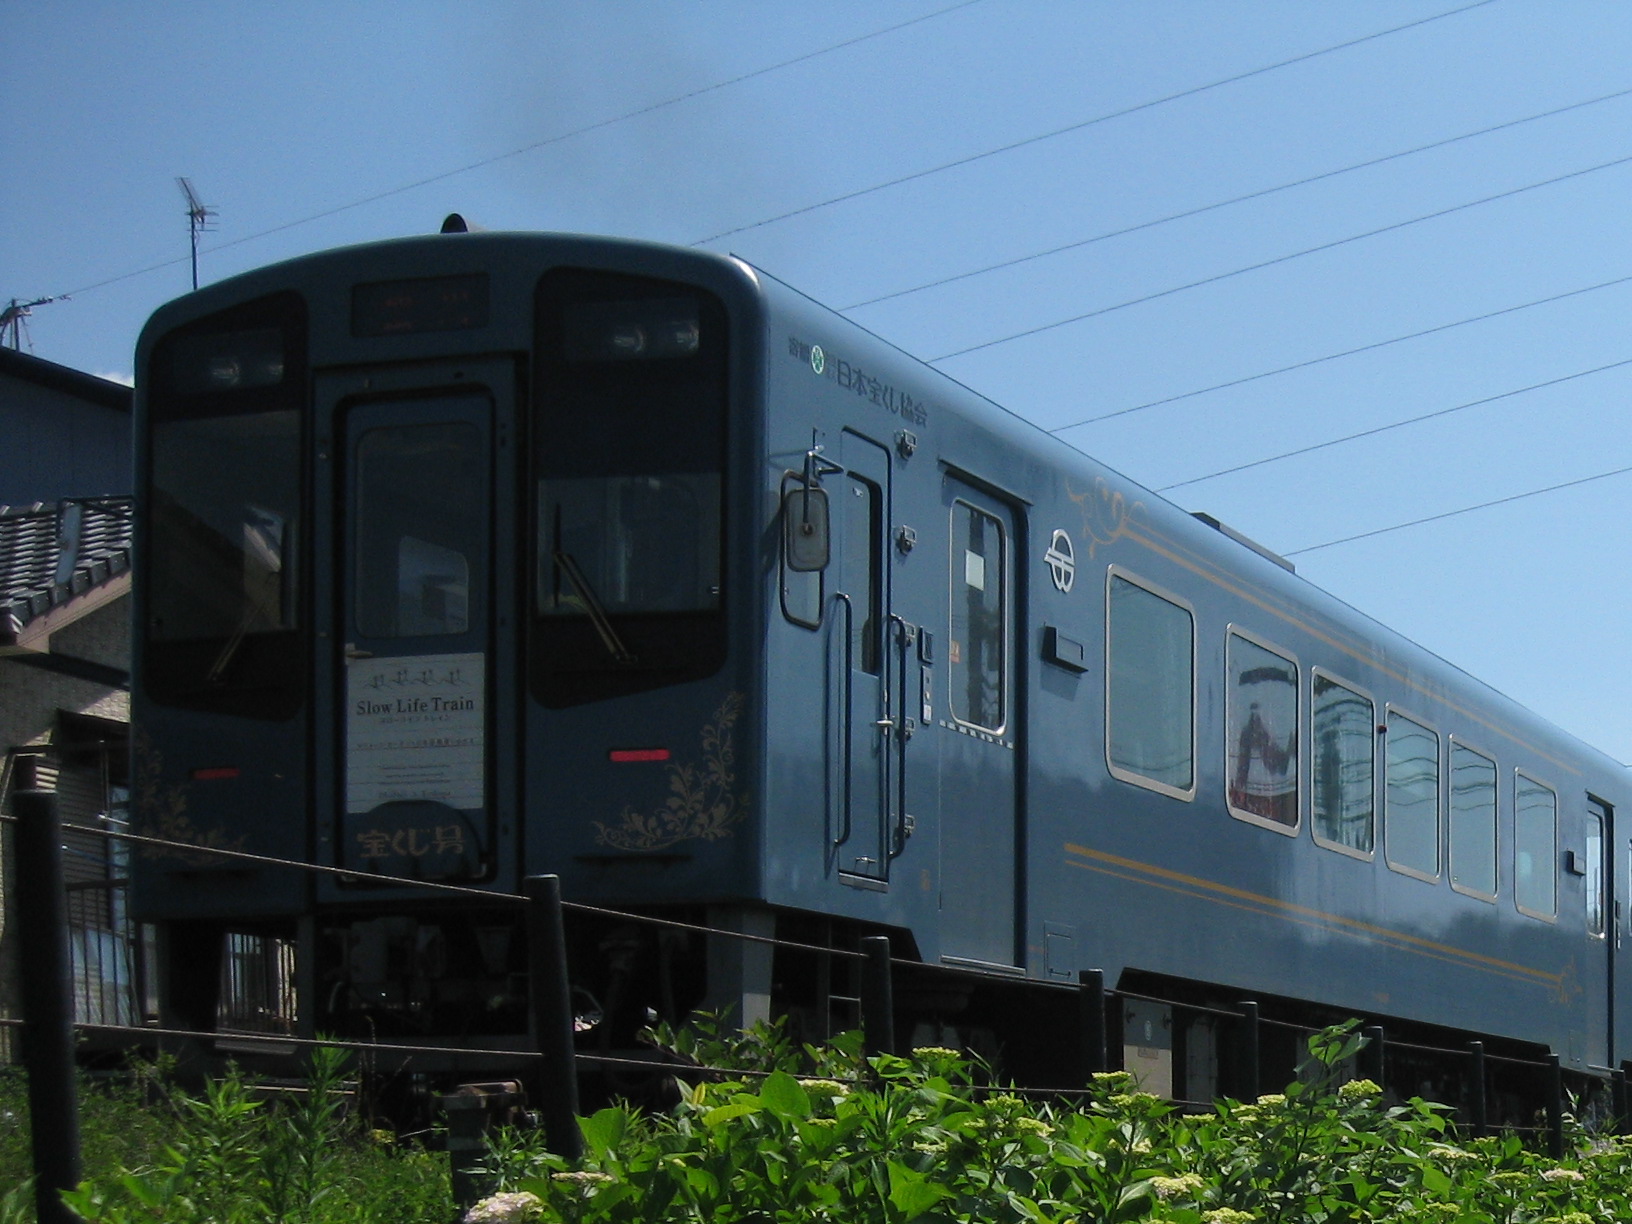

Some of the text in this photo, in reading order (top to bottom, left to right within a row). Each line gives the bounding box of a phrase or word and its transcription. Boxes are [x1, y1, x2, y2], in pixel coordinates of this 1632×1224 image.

[356, 696, 474, 716] Slow Life Train
[357, 825, 464, 858] 宝くじ号
